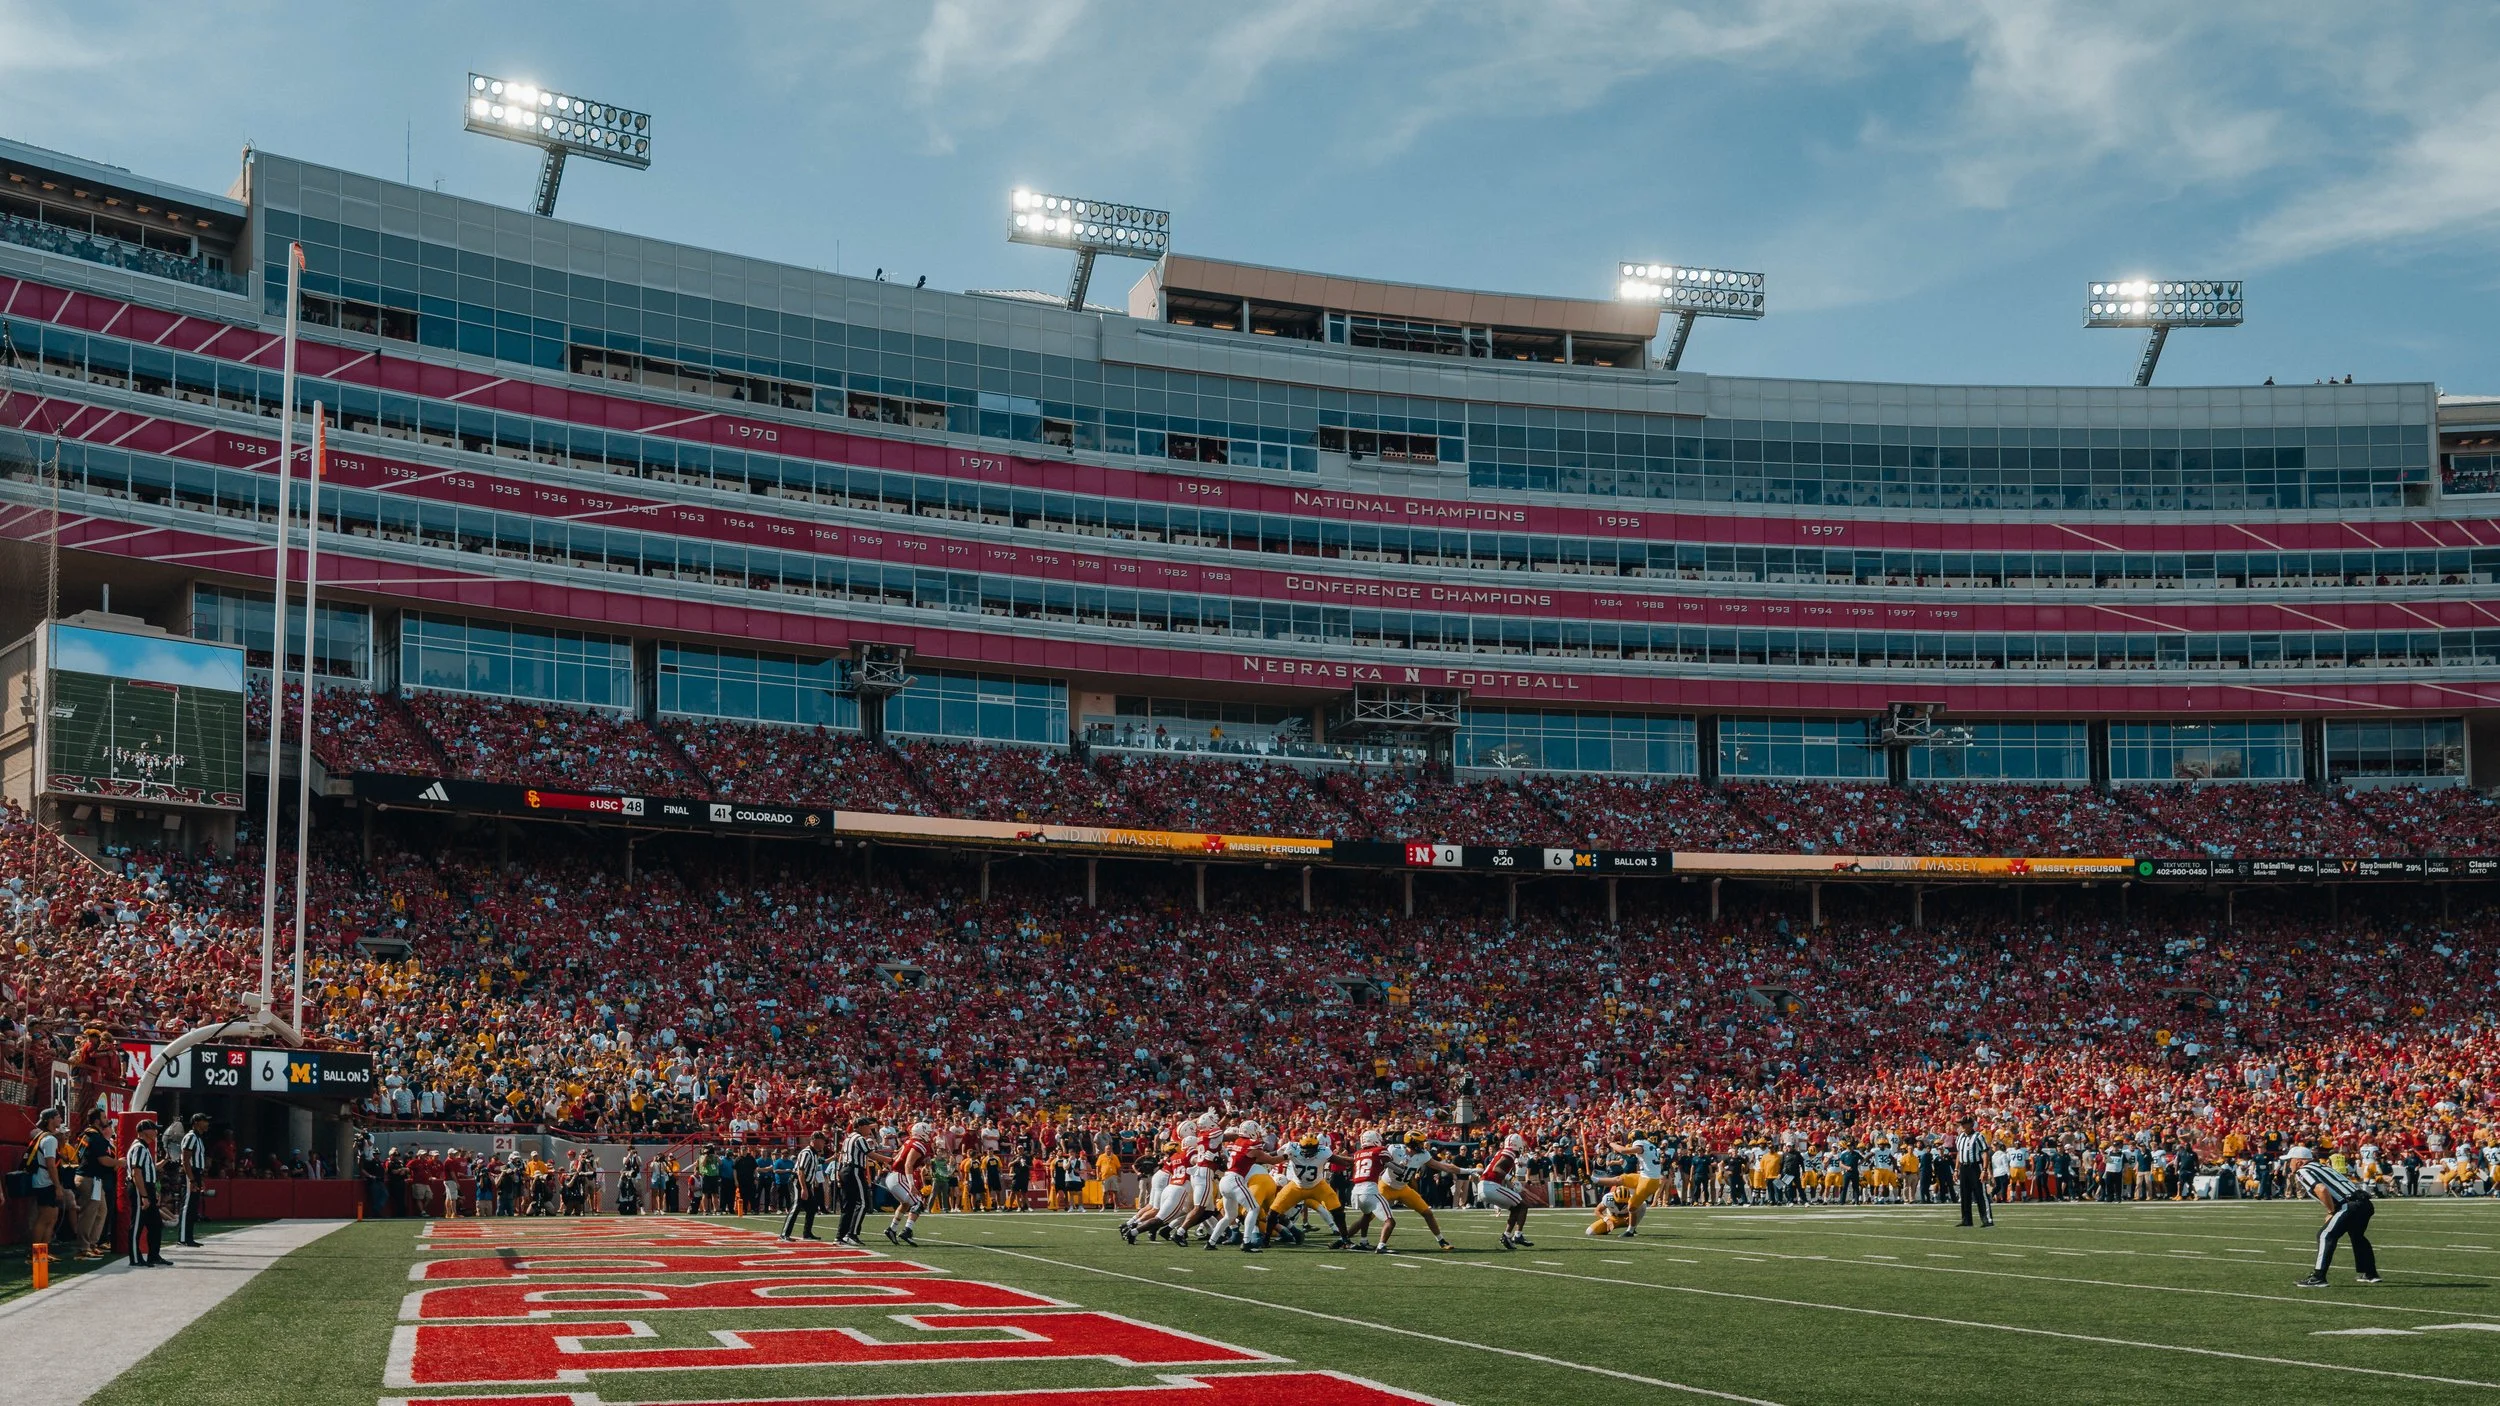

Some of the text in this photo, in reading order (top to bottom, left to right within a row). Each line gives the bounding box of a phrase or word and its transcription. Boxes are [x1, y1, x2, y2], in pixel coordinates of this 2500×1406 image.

[727, 423, 778, 442] 1970
[227, 440, 267, 456] 1928
[334, 458, 367, 472] 1931
[959, 456, 1004, 472] 1971
[383, 466, 419, 480] 1932
[441, 476, 475, 489] 1933
[489, 483, 521, 496] 1935
[1177, 482, 1223, 497] 1994
[534, 490, 568, 504] 1936
[579, 498, 614, 510] 1937
[1294, 491, 1526, 522] NATIONAL CHAMPIONS
[672, 511, 705, 523] 1963
[722, 517, 755, 529] 1964
[1597, 516, 1640, 528] 1995
[766, 523, 796, 535] 1965
[808, 529, 839, 541] 1966
[1801, 525, 1844, 537] 1997
[852, 535, 883, 546] 1969
[896, 540, 928, 551] 1970
[940, 544, 970, 555] 1971
[987, 550, 1018, 560] 1972
[1029, 554, 1060, 565] 1975
[1071, 559, 1100, 570] 1978
[1112, 563, 1142, 573] 1981
[1157, 567, 1188, 578] 1982
[1201, 572, 1232, 581] 1983
[1285, 575, 1552, 607] CONFERENCE CHAMPIONS
[1243, 656, 1580, 689] NEBRASKA N FOOTBALL
[596, 800, 618, 811] USC
[626, 800, 642, 813] 48
[663, 804, 689, 816] FINAL
[714, 807, 793, 824] 41 COLORADO
[1089, 831, 1110, 844] MY
[1229, 842, 1320, 855] MASSEY FERGUSON
[1414, 847, 1431, 863] N
[1444, 849, 1455, 863] 0
[1492, 856, 1514, 867] 9:20
[1552, 852, 1562, 866] 6
[1575, 853, 1592, 867] M
[1614, 857, 1657, 866] BALL ON 3
[1902, 858, 1920, 870] MY
[2033, 864, 2122, 873] MASSEY FERGUSON
[2298, 865, 2314, 873] 62%
[2405, 864, 2422, 872] 29%
[201, 1051, 244, 1065] 1ST 25
[205, 1068, 239, 1086] 9:20
[262, 1060, 274, 1082] 6
[290, 1062, 311, 1083] M
[323, 1069, 370, 1083] BALL ON 3
[495, 1138, 513, 1150] 21
[1295, 1165, 1318, 1182] 73
[1354, 1158, 1373, 1178] 12
